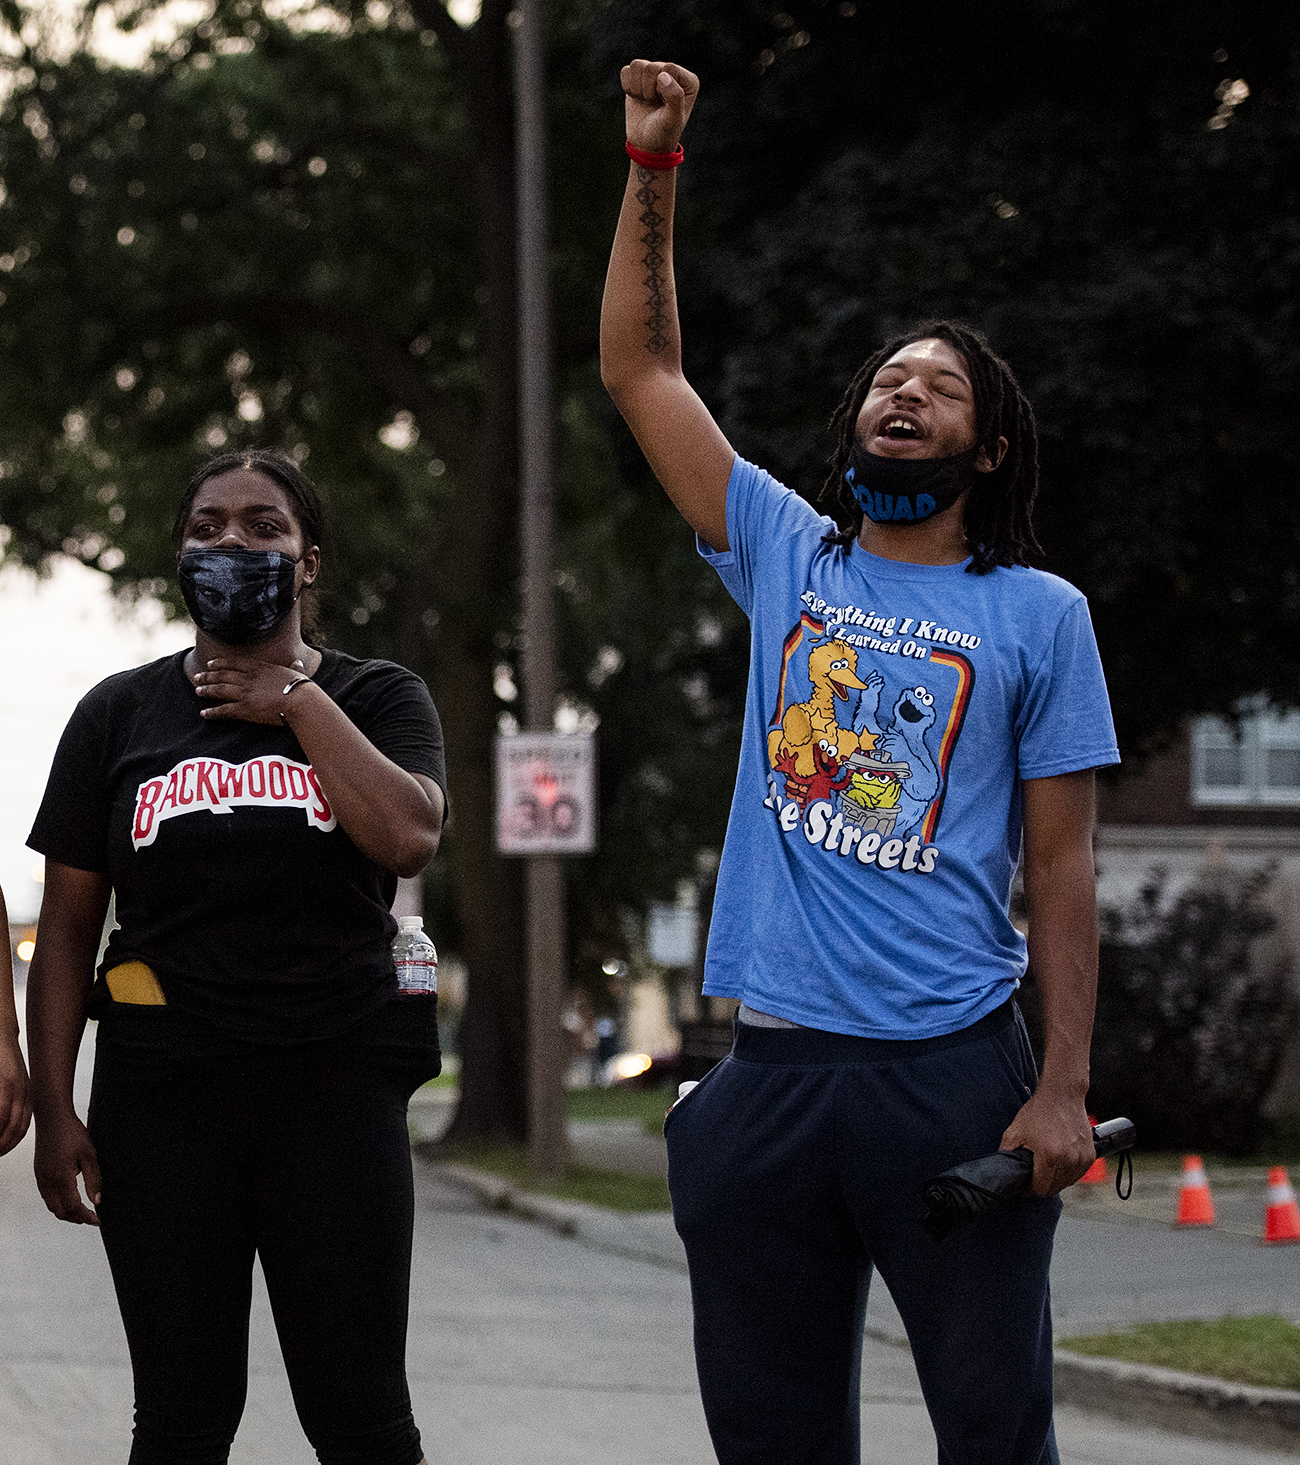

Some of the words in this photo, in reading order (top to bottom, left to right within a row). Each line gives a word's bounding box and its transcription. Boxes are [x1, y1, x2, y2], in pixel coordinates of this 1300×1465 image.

[800, 590, 897, 638] Everything
[897, 618, 915, 635] I
[915, 620, 982, 650] Know
[833, 627, 902, 656] Learned
[902, 639, 928, 660] On
[133, 760, 333, 841] BACKWOODS
[517, 790, 580, 839] 30
[804, 801, 939, 873] Streets
